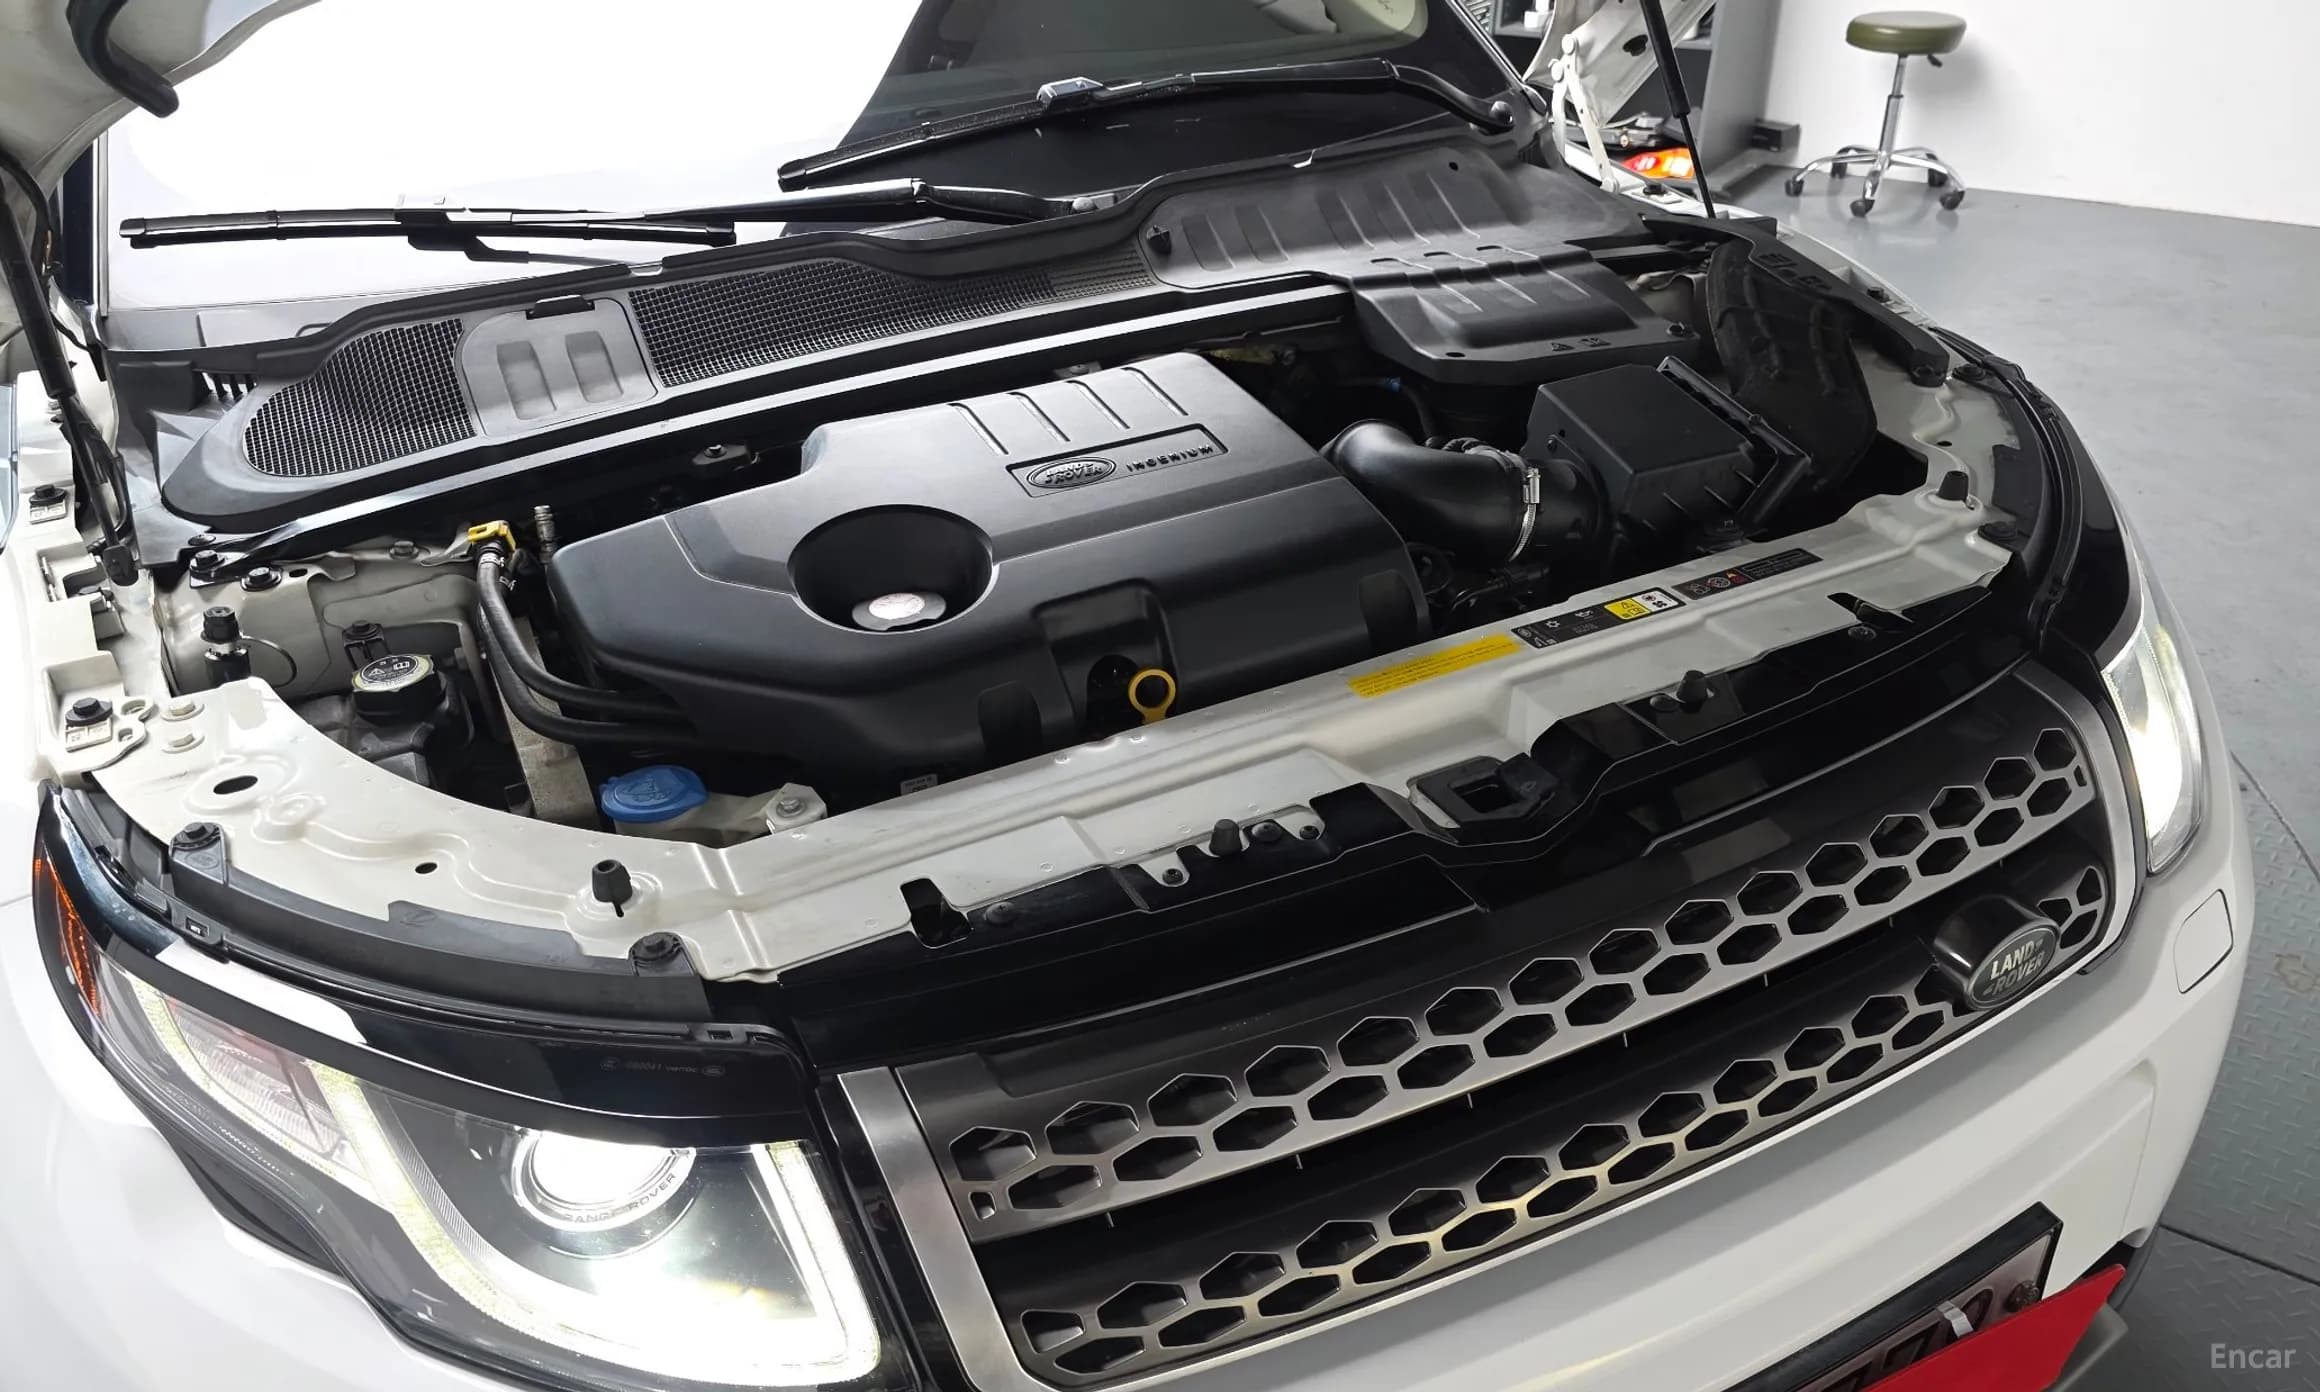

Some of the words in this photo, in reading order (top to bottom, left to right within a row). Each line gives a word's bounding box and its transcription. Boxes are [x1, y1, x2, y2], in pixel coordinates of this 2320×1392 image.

[1126, 446, 1213, 472] INGENIUM
[1990, 939, 2034, 981] LAND
[1992, 951, 2046, 996] ROVER
[626, 1173, 677, 1212] ROVER
